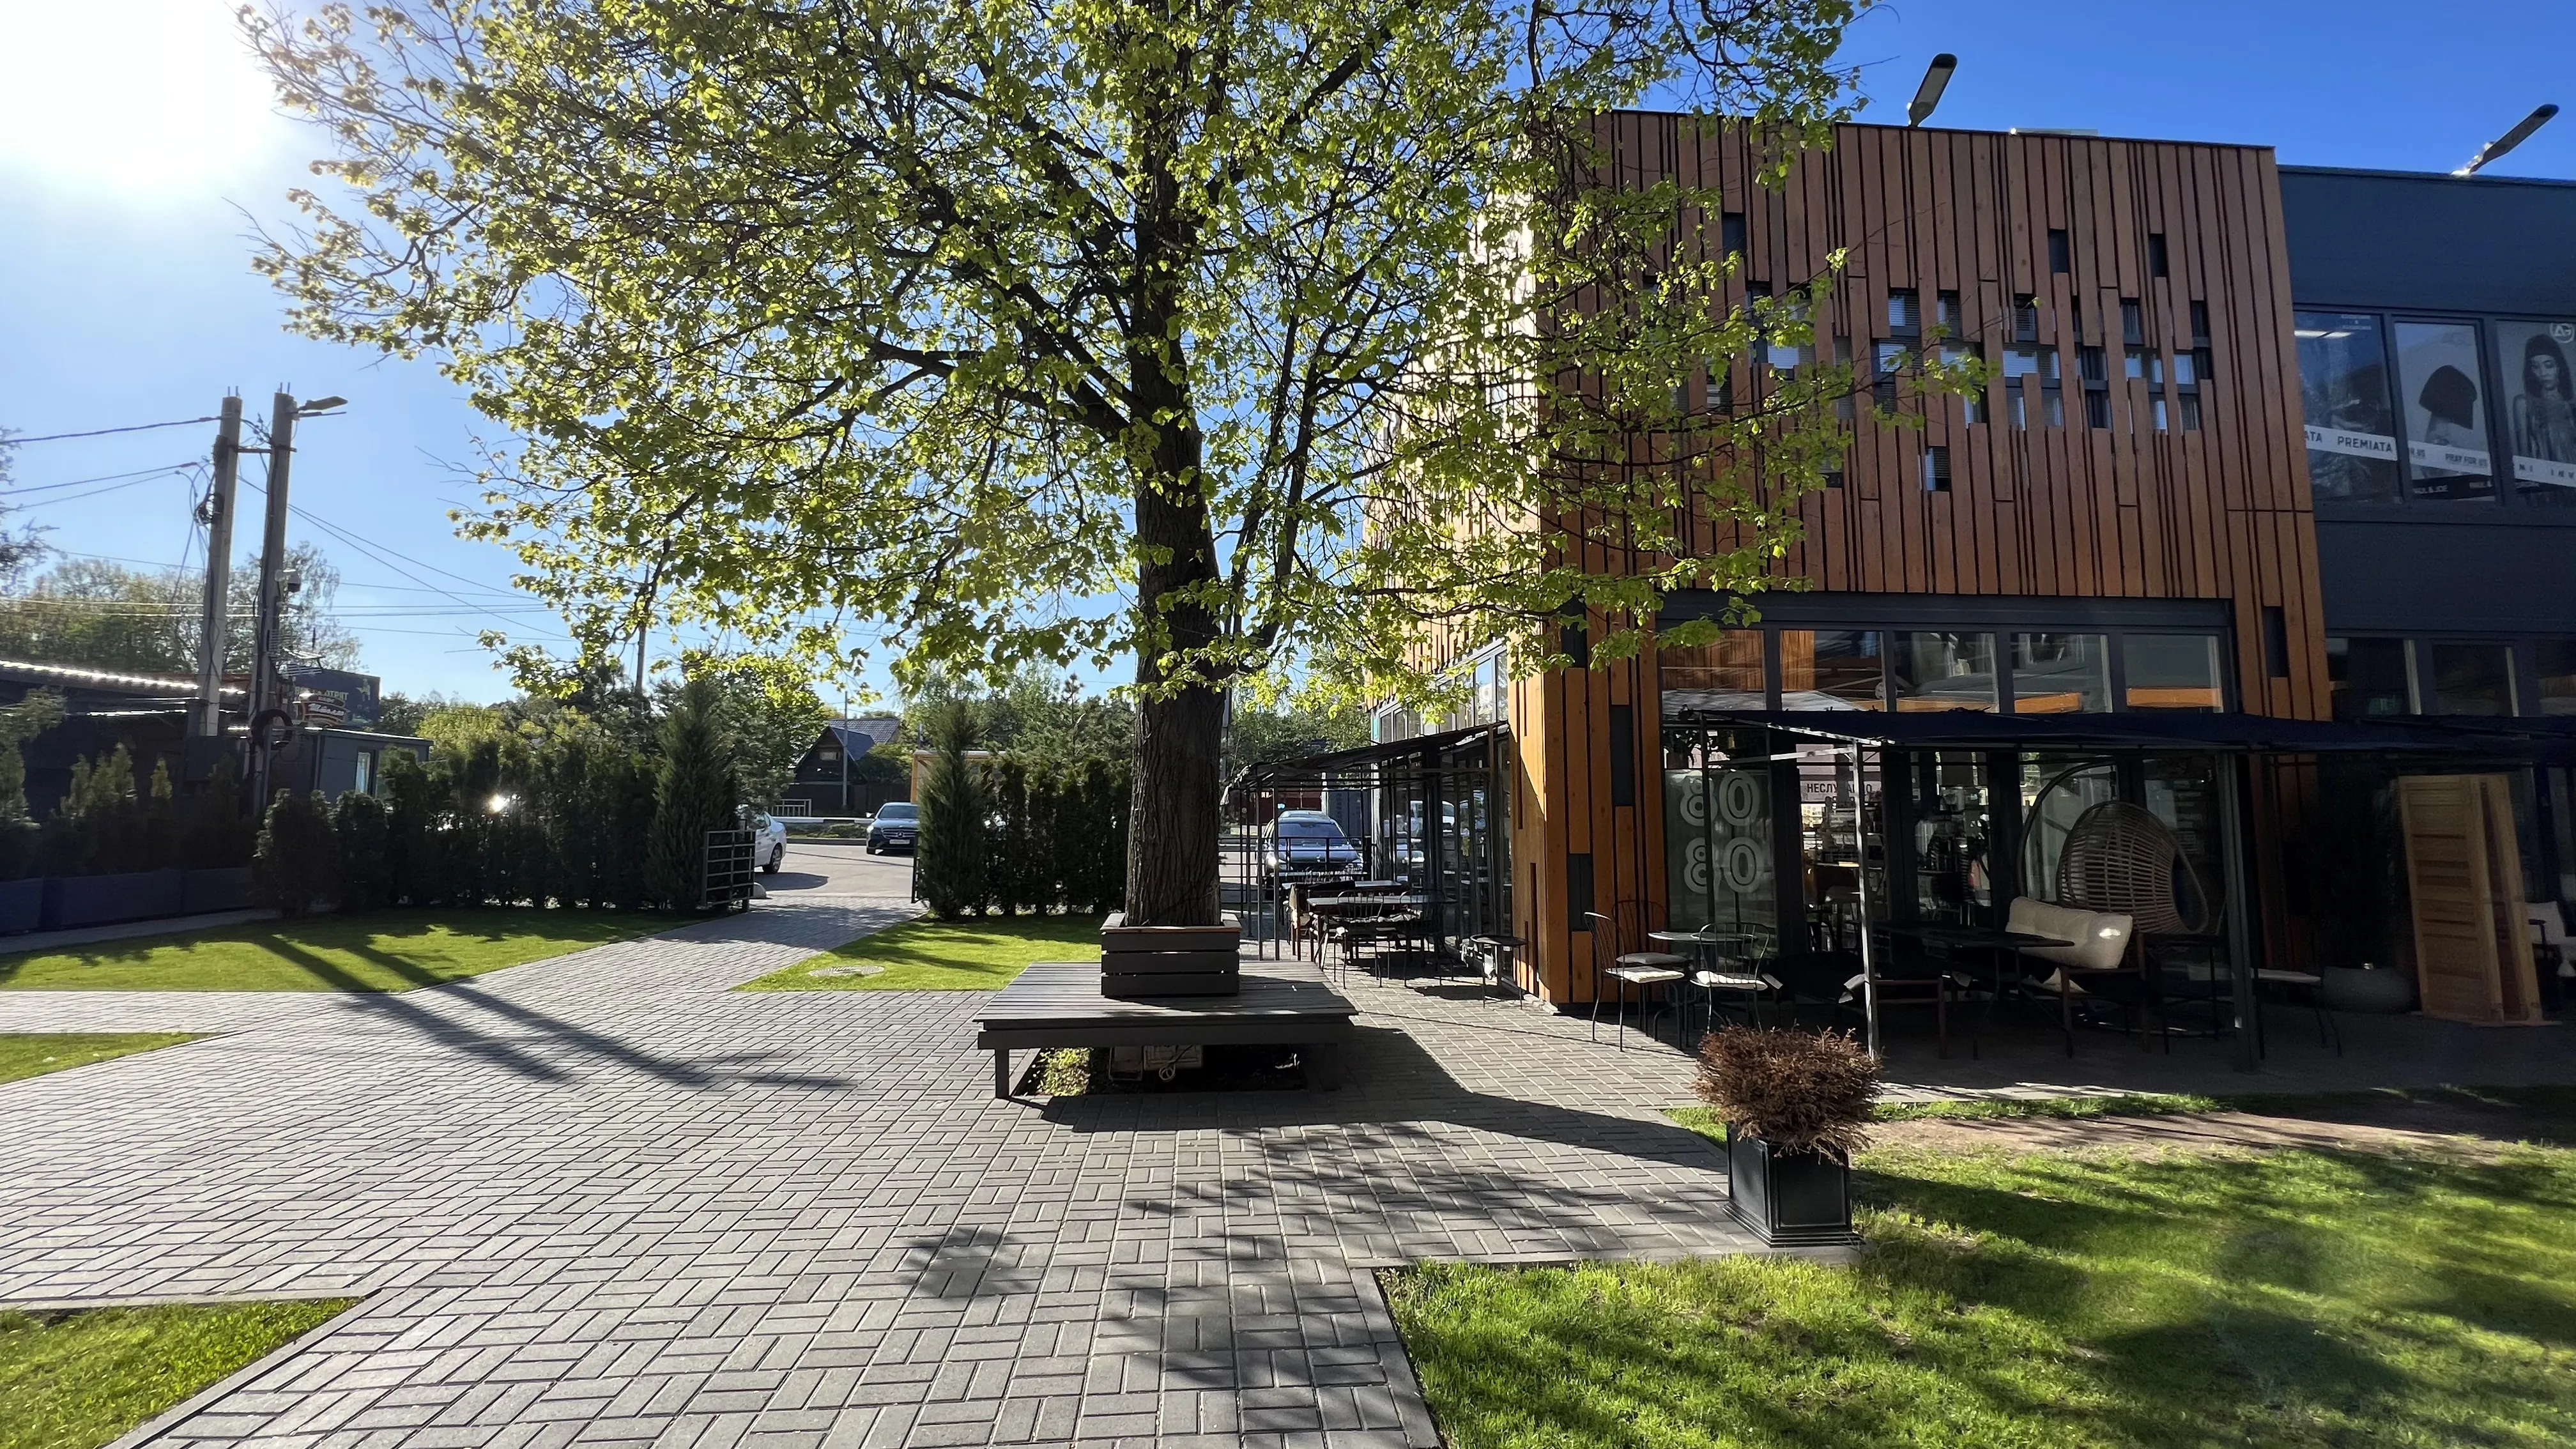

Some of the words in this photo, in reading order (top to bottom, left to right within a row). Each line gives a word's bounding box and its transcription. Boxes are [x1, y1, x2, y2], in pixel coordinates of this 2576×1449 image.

[2337, 436, 2393, 452] PREMIATA
[1680, 770, 1760, 826] 80
[1807, 783, 1872, 793] НЕСЛУАО
[1684, 837, 1763, 894] 80
